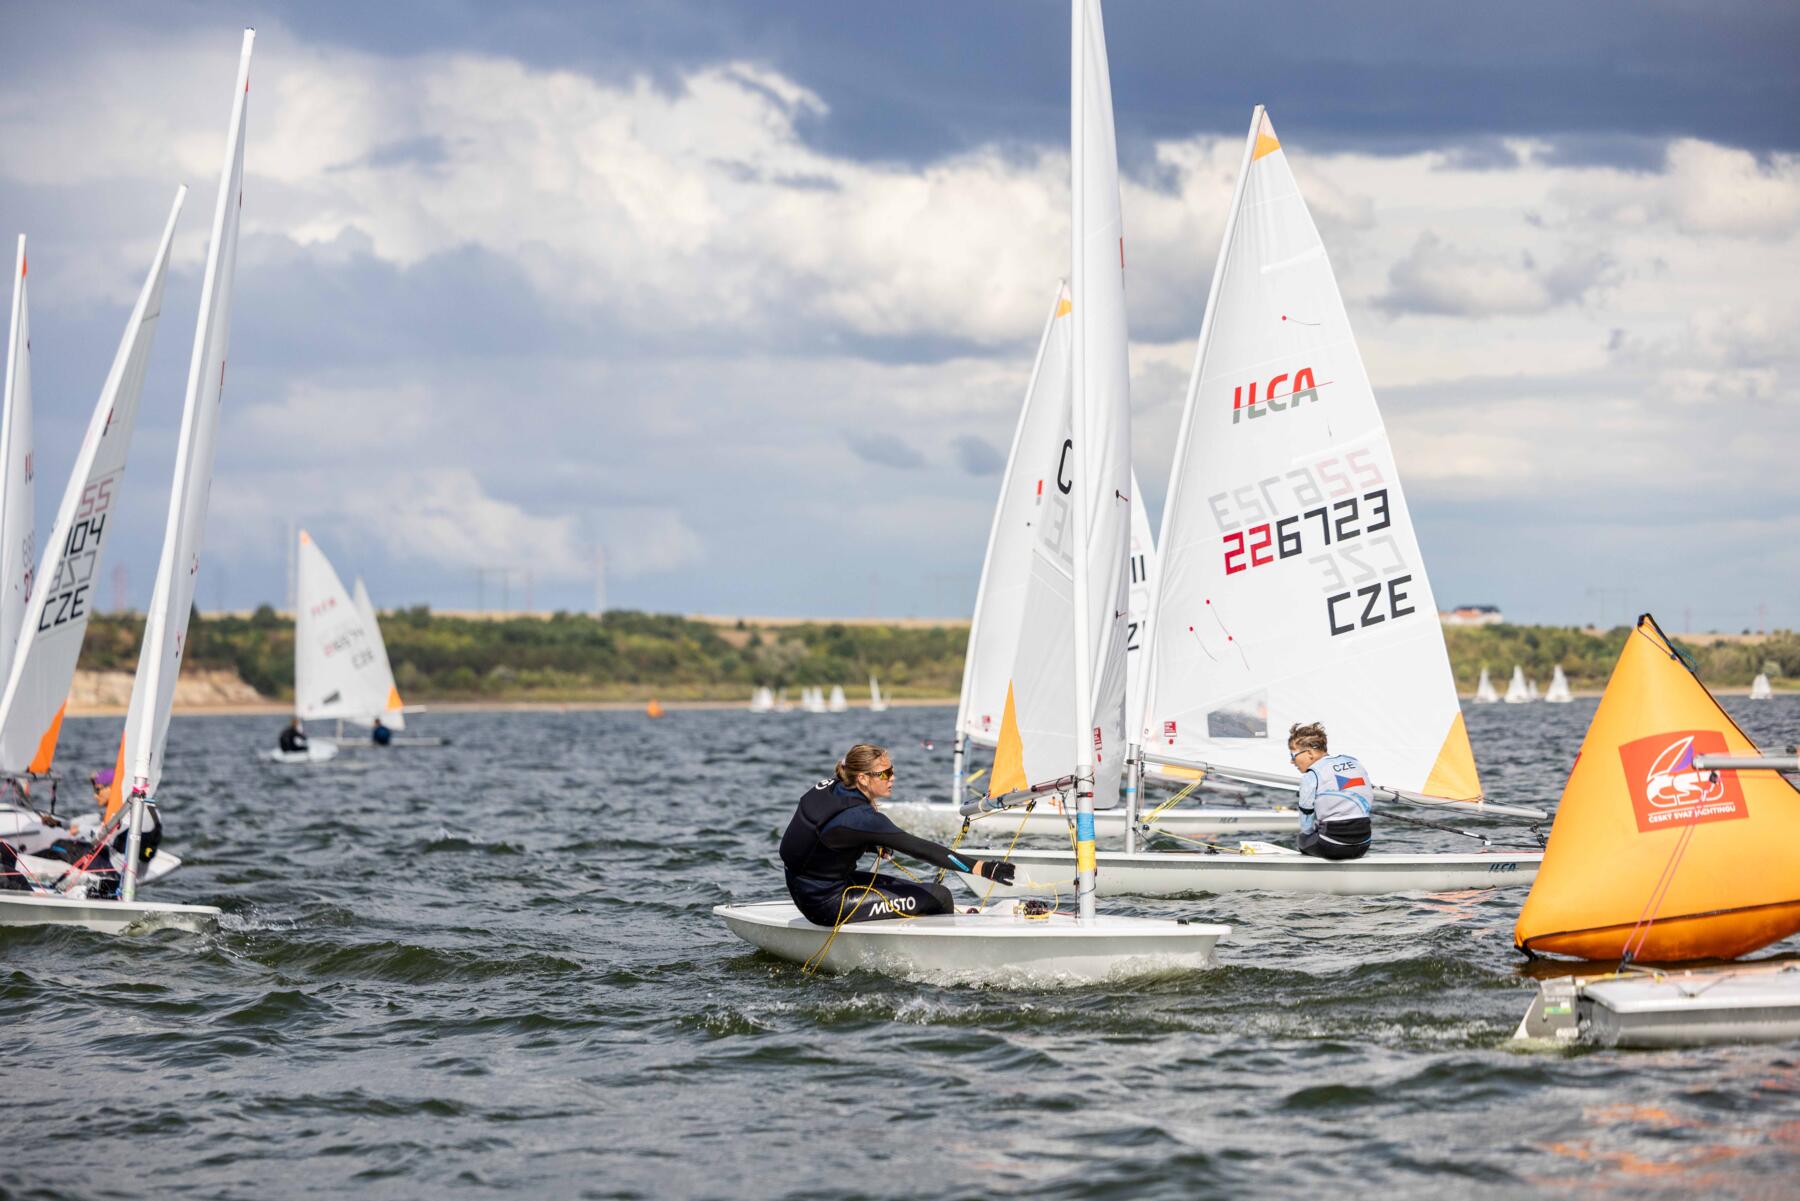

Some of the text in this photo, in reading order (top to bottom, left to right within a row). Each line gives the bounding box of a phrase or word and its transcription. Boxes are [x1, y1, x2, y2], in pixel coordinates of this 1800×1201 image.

[1232, 367, 1319, 424] ILCA
[1222, 488, 1391, 576] 226723
[38, 585, 90, 633] CZE
[1326, 574, 1416, 637] CZE
[1332, 761, 1356, 773] CZE
[1488, 863, 1517, 873] ILCA
[869, 896, 916, 917] MUSTO
